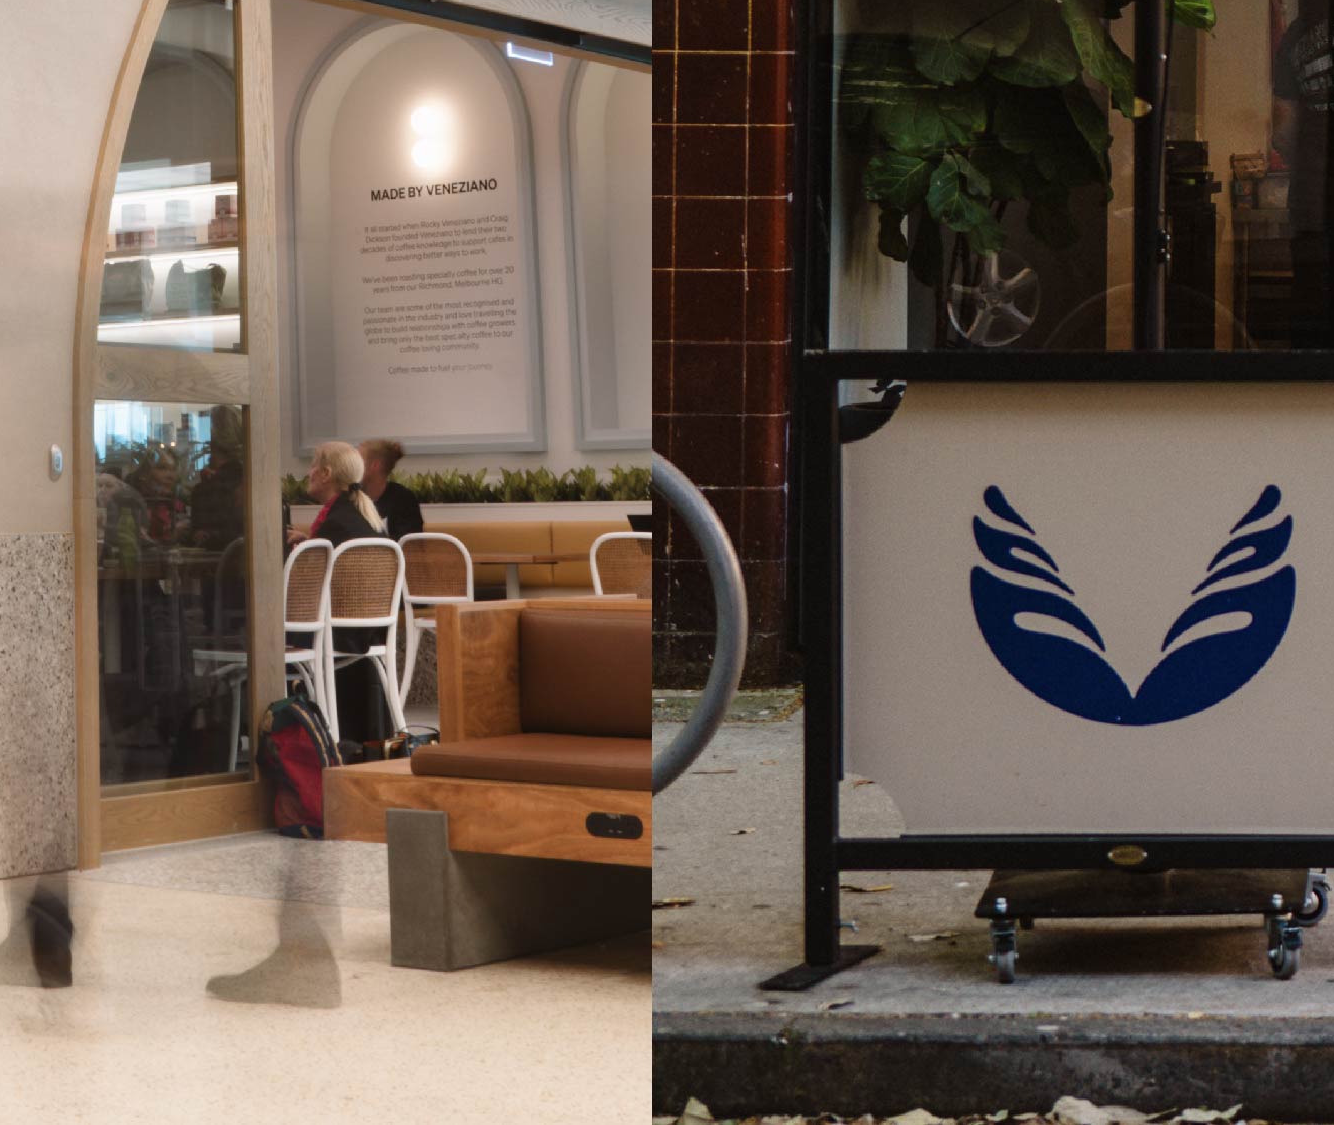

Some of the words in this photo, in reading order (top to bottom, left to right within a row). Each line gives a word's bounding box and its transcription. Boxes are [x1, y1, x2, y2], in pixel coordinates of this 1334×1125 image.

[370, 187, 406, 201] MADE
[408, 186, 423, 198] BY
[426, 178, 498, 196] VENEZIANO
